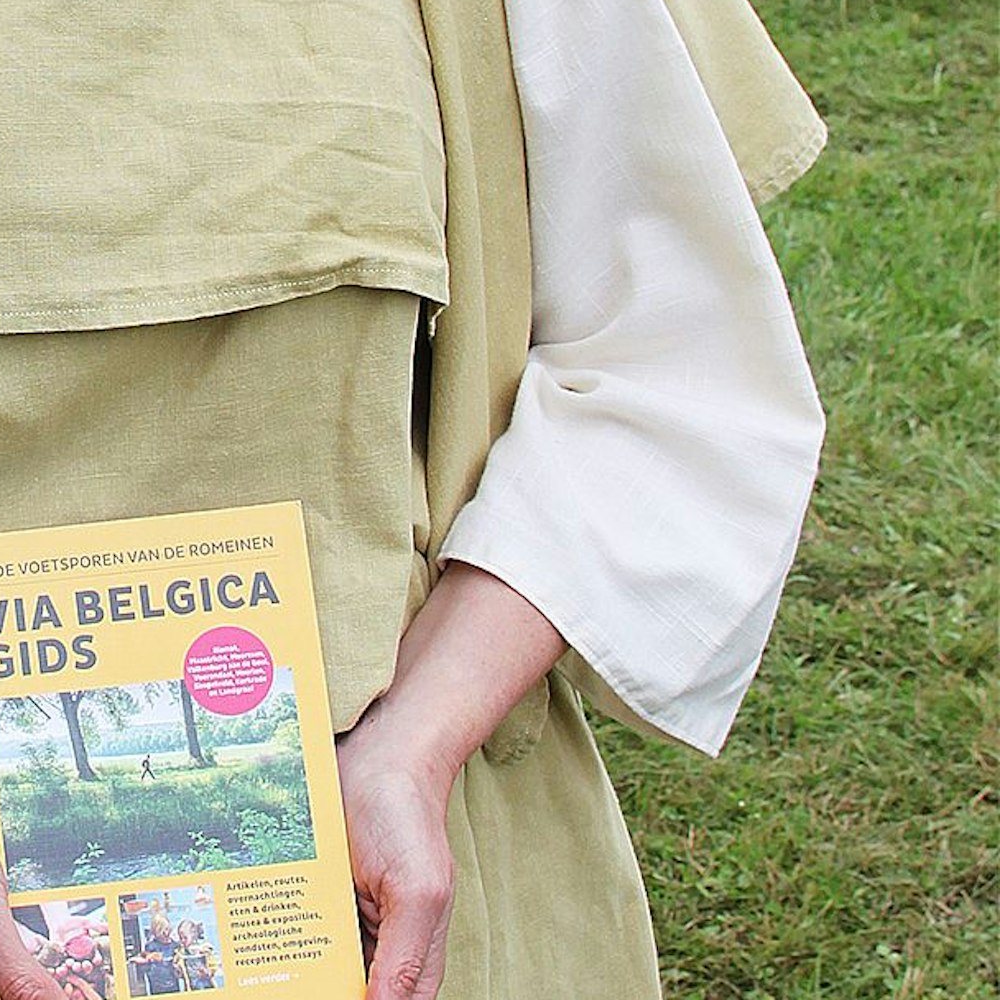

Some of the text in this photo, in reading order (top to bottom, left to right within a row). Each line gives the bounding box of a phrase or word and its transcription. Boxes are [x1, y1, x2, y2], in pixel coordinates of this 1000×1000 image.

[18, 552, 124, 575] VOETSPOREN
[126, 547, 160, 564] VAN
[164, 545, 185, 559] DE
[189, 536, 275, 557] ROMEINEN
[75, 571, 280, 626] BELGICA
[226, 876, 308, 891] Artikelen, routes,
[227, 889, 305, 904] overnachtingen,
[229, 906, 251, 916] eten
[230, 918, 261, 928] musea
[232, 926, 302, 941] archeologische
[235, 955, 277, 966] recepten
[292, 950, 322, 960] essays
